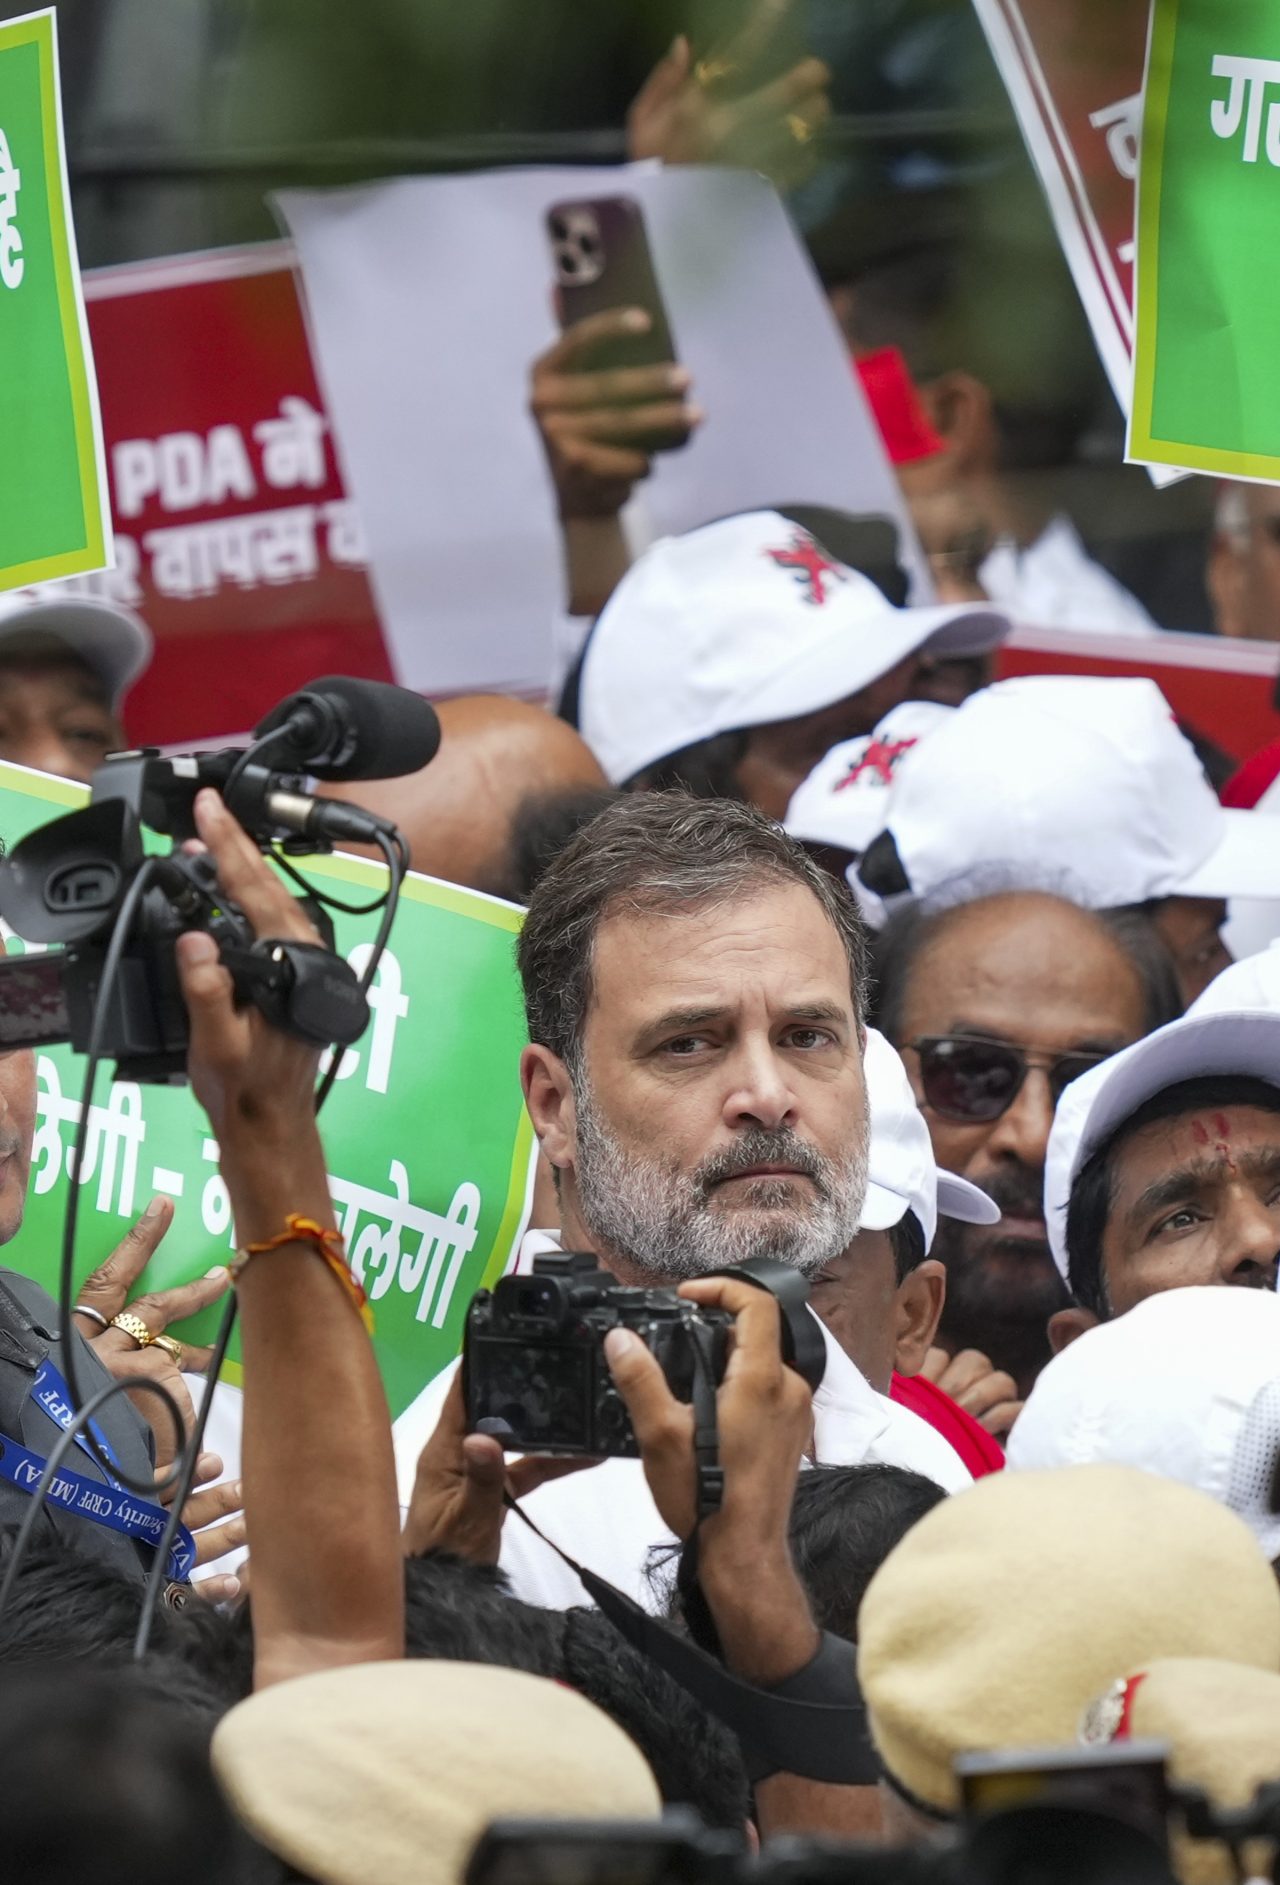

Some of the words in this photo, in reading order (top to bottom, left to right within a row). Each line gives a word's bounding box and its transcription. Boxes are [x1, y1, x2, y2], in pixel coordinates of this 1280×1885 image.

[111, 425, 257, 519] PDA
[142, 507, 318, 600] वापस
[76, 1490, 113, 1517] CRPF
[114, 1499, 167, 1535] Security
